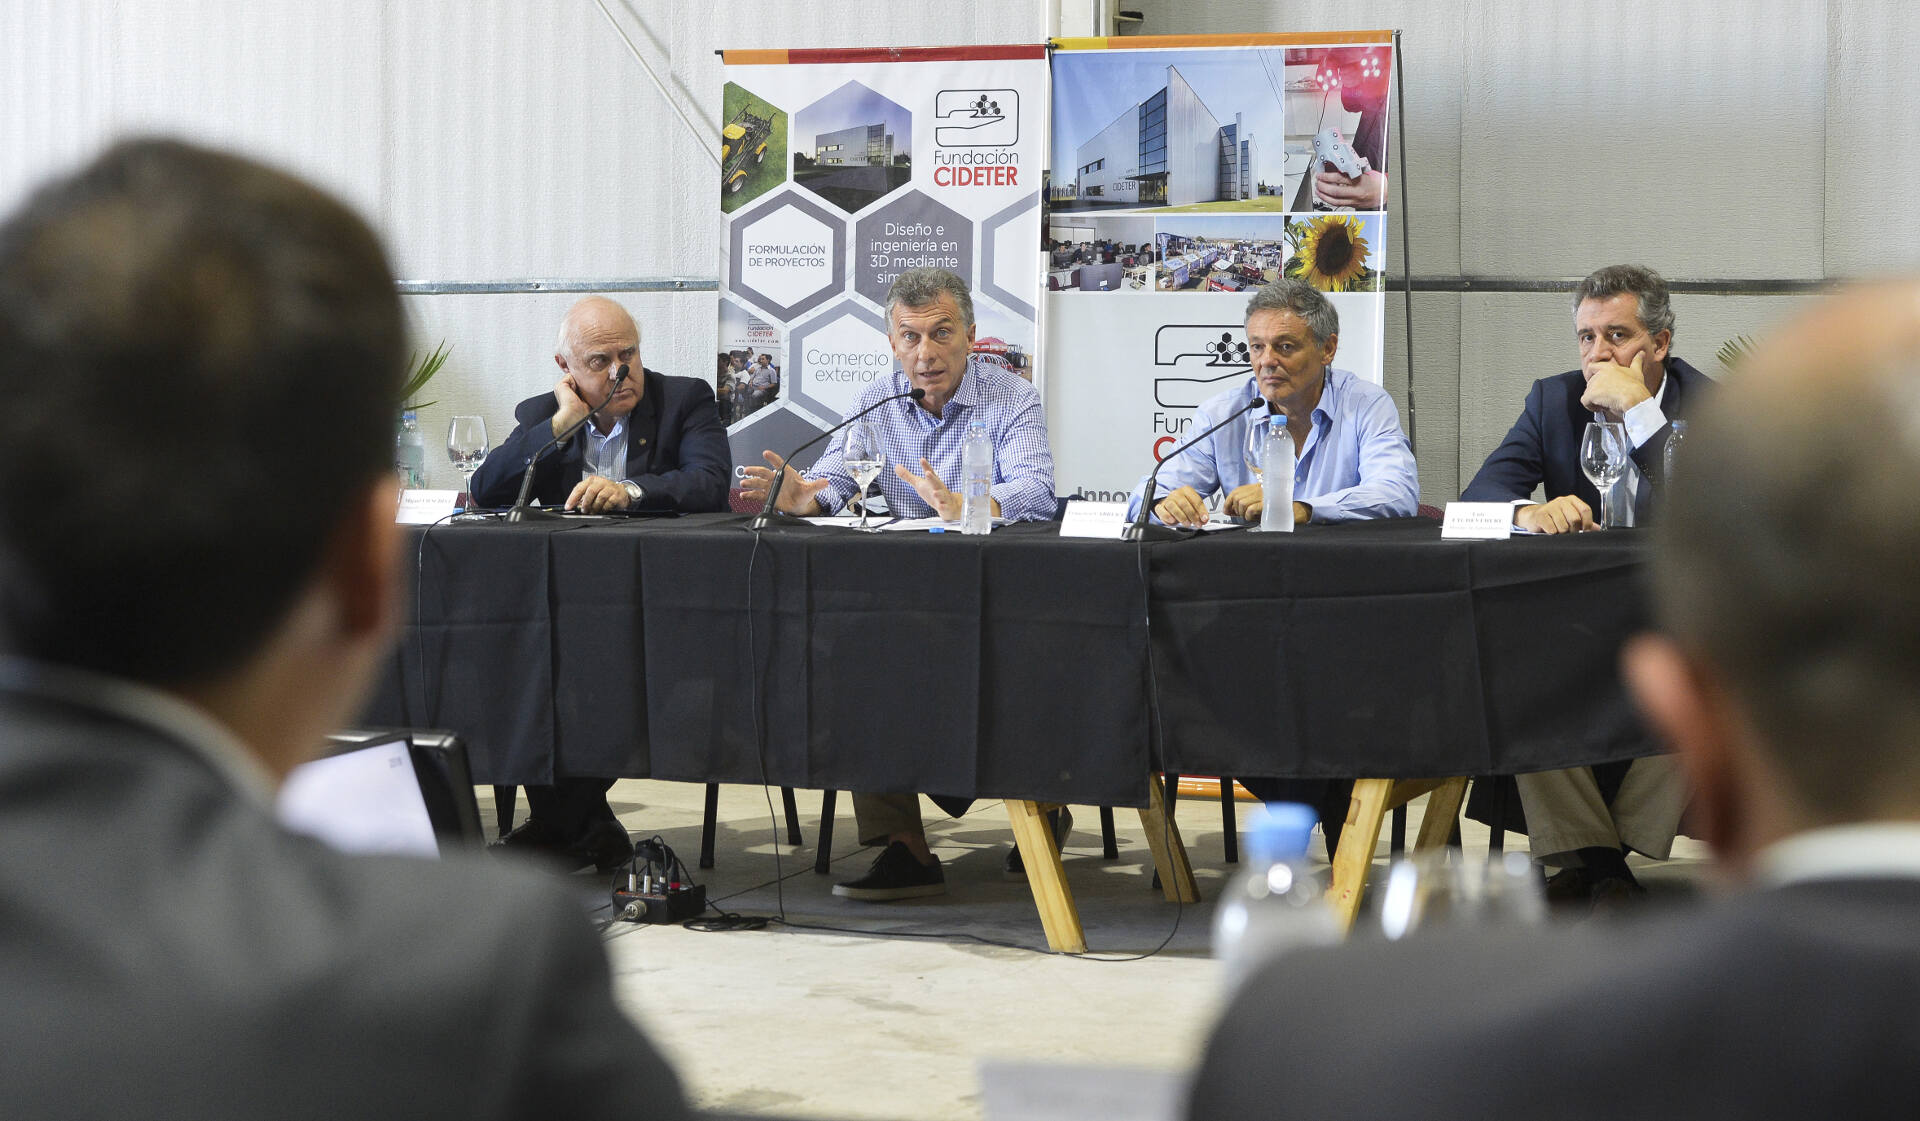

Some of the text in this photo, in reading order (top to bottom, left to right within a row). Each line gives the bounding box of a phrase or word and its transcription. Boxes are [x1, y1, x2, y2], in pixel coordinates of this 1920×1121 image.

[934, 148, 1019, 165] Fundación
[933, 166, 1018, 187] CIDETER
[885, 223, 945, 236] Diseño e
[748, 243, 826, 255] FORMULACIÓN
[870, 239, 958, 254] ingeniería en
[748, 257, 825, 267] DE PROYECTOS
[870, 254, 959, 268] 3D mediante
[806, 349, 889, 366] Comercio
[815, 367, 880, 383] exterior
[1209, 494, 1222, 511] y
